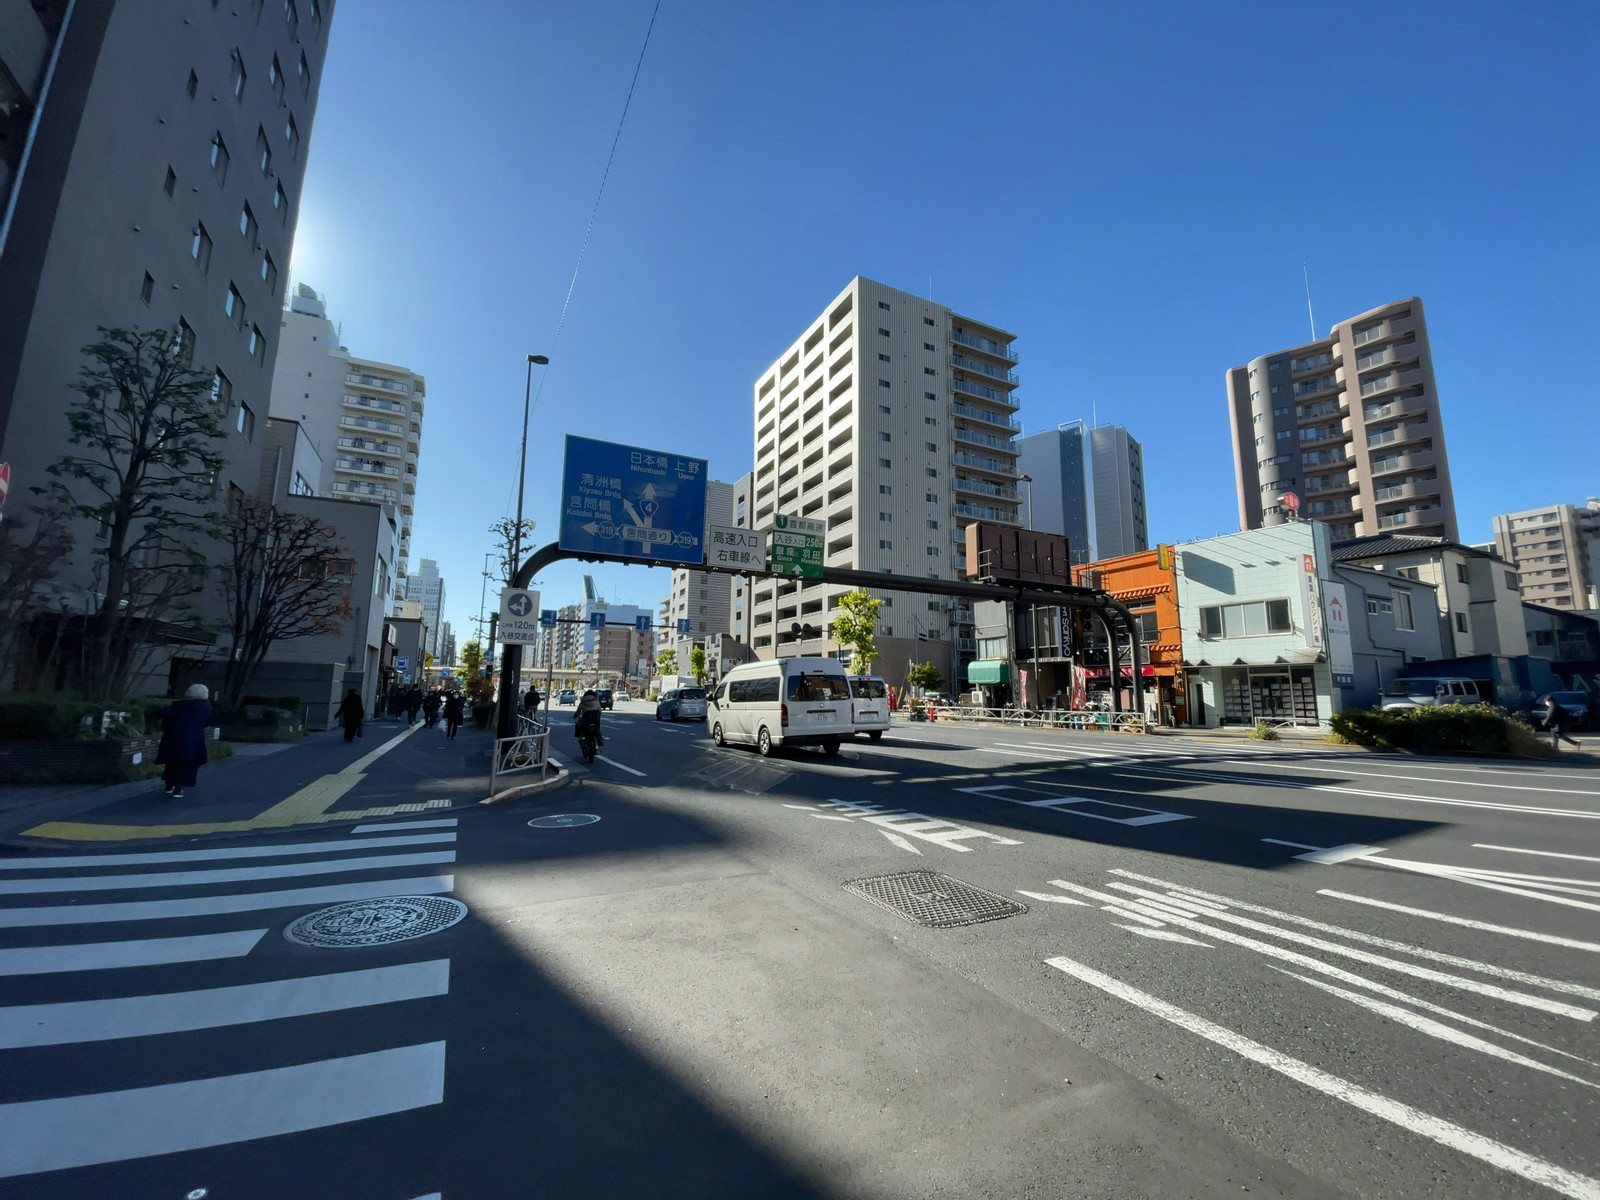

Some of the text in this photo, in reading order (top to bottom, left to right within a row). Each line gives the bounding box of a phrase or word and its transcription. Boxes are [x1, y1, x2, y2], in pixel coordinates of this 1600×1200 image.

[630, 451, 700, 475] 日本橋 上野
[630, 463, 695, 481] Nihonbashi Ueno
[580, 472, 622, 491] 清洲橋
[578, 485, 623, 500] Kiyosu Brdg.
[569, 495, 611, 513] 言問橋
[645, 502, 653, 513] 4
[566, 507, 613, 521] Kototoi Brdg.
[600, 525, 614, 535] 319
[789, 519, 824, 533] 首都高速
[626, 528, 668, 542] 言問通り
[679, 535, 692, 545] 319
[713, 531, 758, 548] 高速入口
[775, 533, 805, 546] 入谷入口
[806, 537, 824, 548] 250m
[717, 548, 762, 565] 右車線へ
[775, 545, 821, 560] 銀座 羽田
